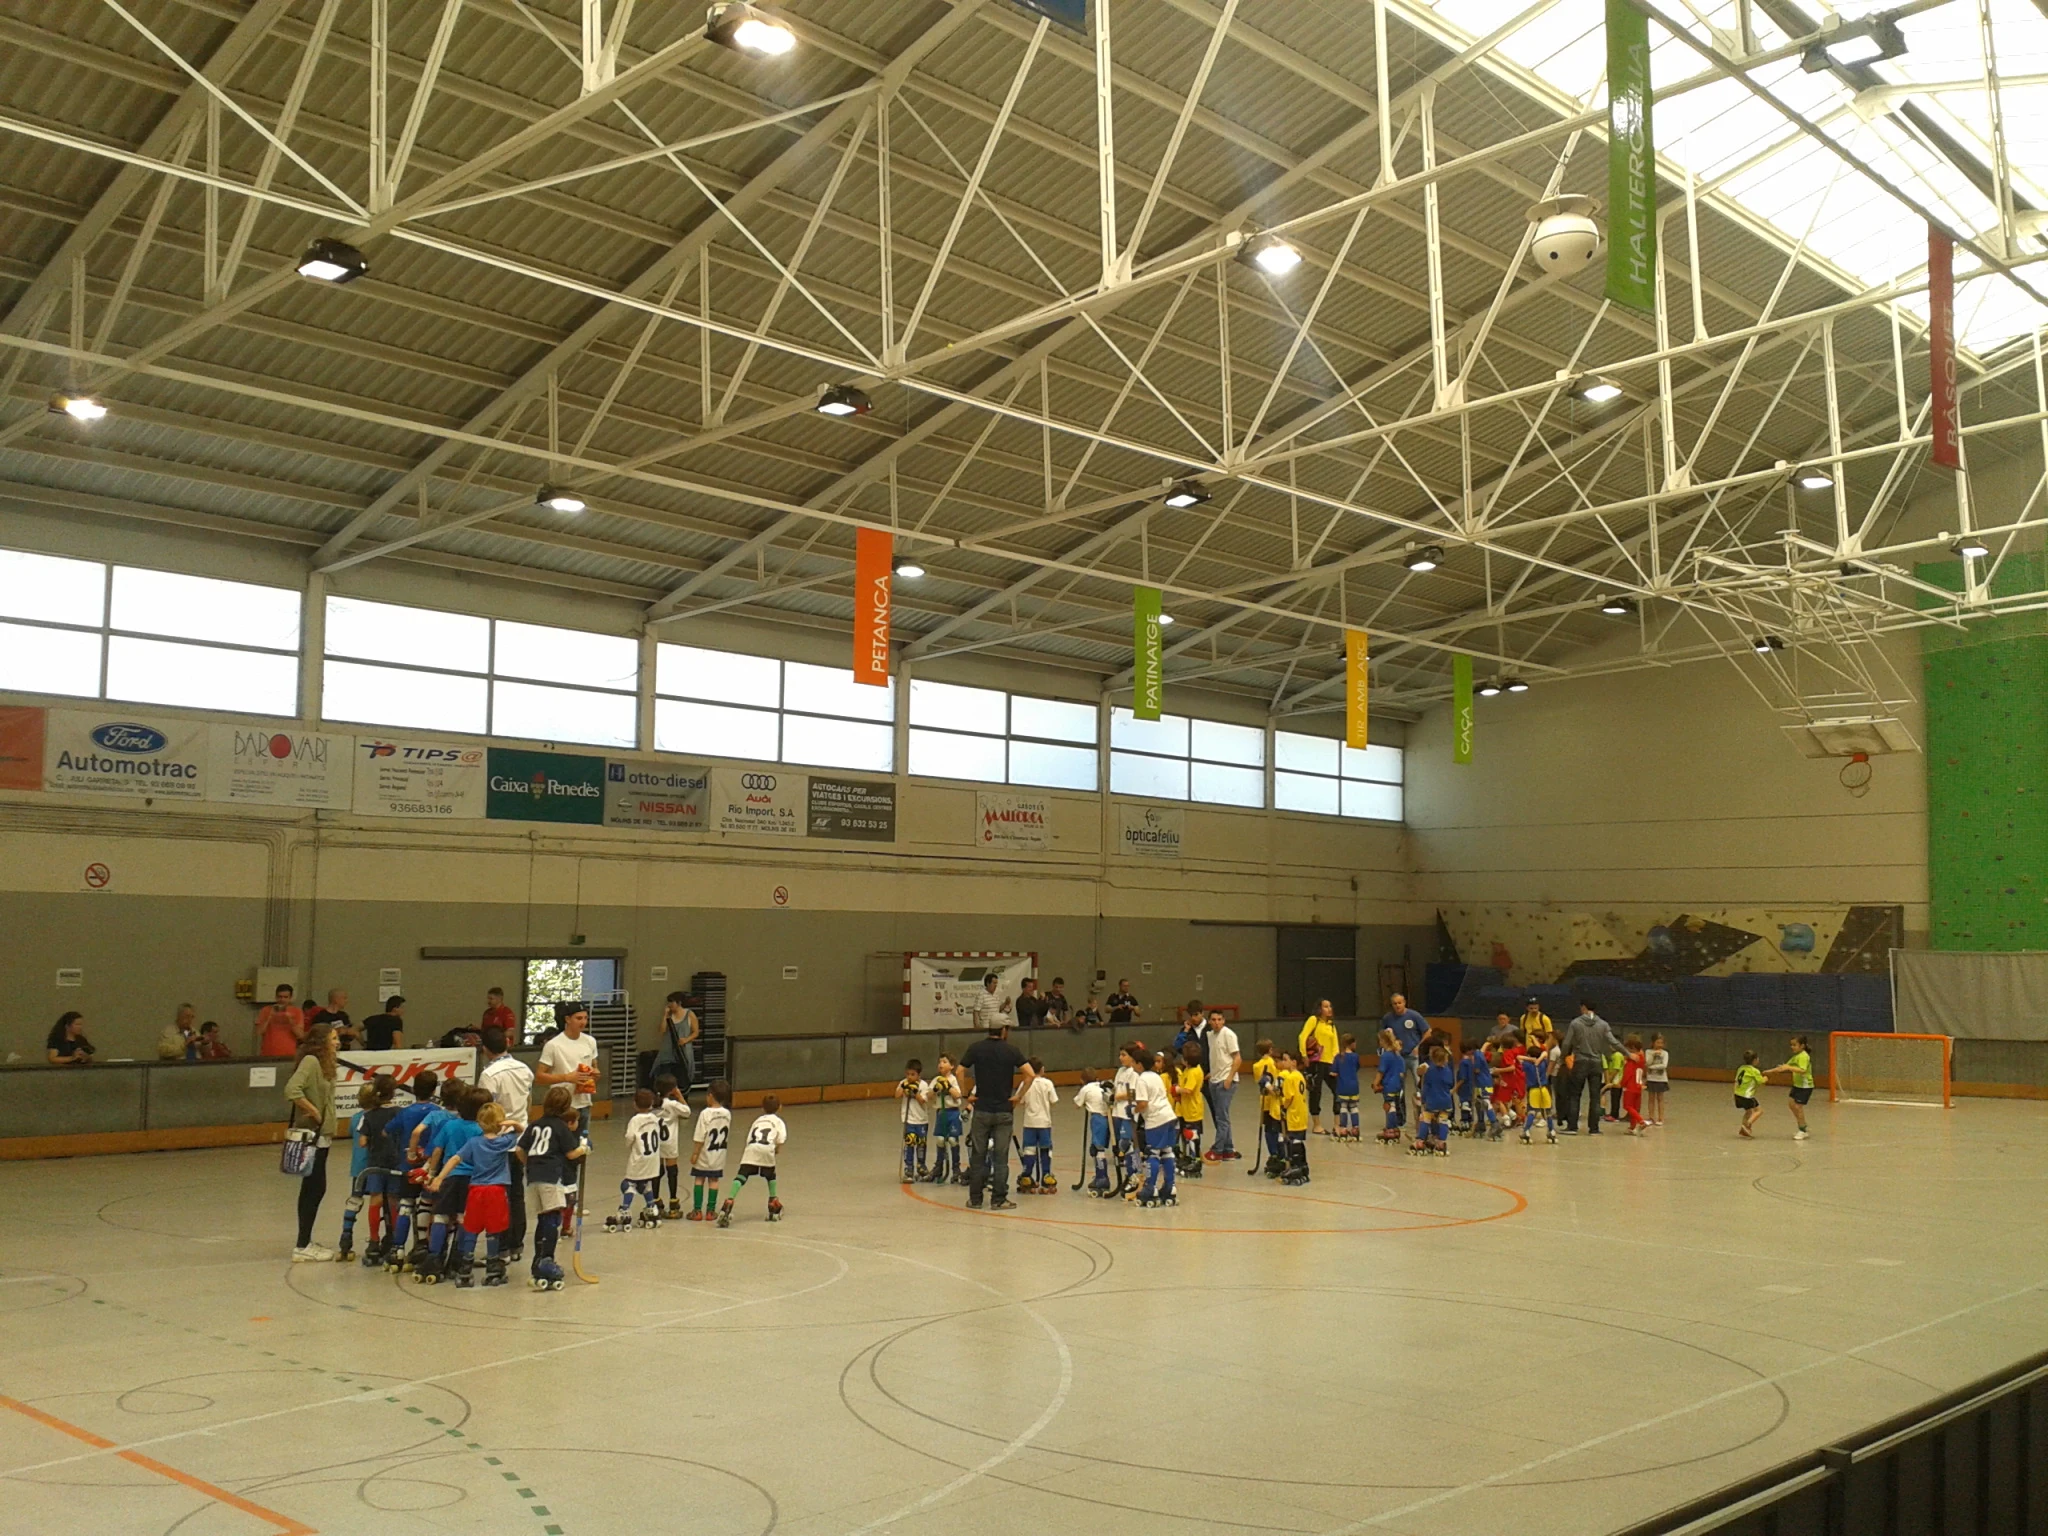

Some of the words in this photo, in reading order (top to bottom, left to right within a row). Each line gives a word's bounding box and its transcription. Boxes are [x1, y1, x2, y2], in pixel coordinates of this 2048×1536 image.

[871, 575, 889, 672] PETANCA
[1145, 613, 1159, 710] PATINATGE
[1357, 639, 1367, 671] ARC
[1357, 680, 1366, 713] AMB
[103, 726, 152, 749] Ford
[1356, 720, 1365, 740] TIR
[1460, 706, 1472, 754] CAÇA
[56, 750, 198, 779] Automotrac
[490, 775, 529, 793] Caixa
[547, 778, 600, 798] Penedès
[629, 772, 707, 789] otto-diesel
[812, 782, 852, 794] AUTOCARS
[852, 787, 867, 795] PER
[745, 793, 772, 803] Audi
[812, 791, 842, 801] VIATGES
[390, 803, 453, 814] 936683166
[639, 801, 697, 815] NISSAN
[728, 804, 742, 814] Rio
[746, 806, 776, 817] Import,
[983, 808, 1044, 826] MALLORCA
[840, 818, 851, 827] 93
[852, 819, 867, 828] 632
[868, 820, 878, 828] 53
[879, 821, 888, 829] 25
[528, 1125, 552, 1156] 28
[640, 1131, 659, 1156] 10
[708, 1126, 729, 1152] 22
[749, 1126, 772, 1145] 11
